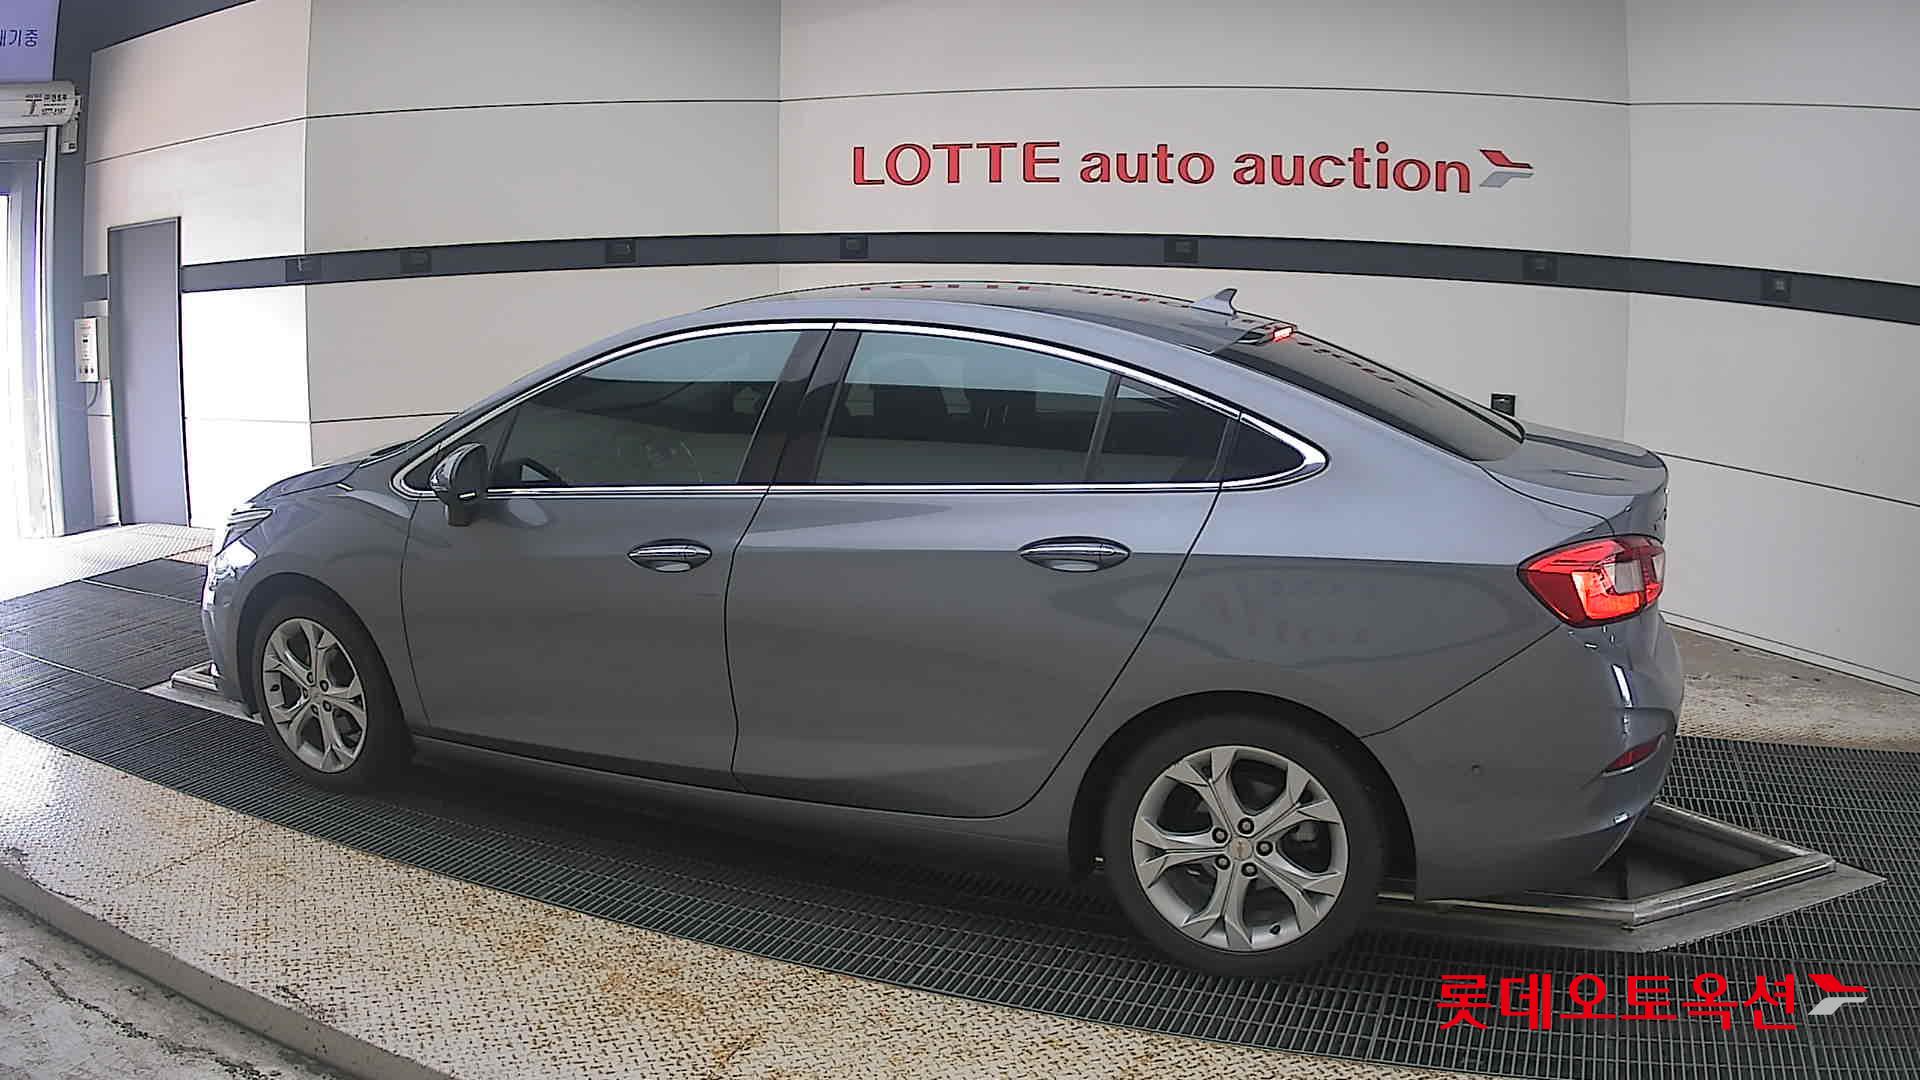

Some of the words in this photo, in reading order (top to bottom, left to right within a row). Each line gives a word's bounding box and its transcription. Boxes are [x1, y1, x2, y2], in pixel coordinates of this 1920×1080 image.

[853, 142, 1060, 186] LOTTE
[1079, 143, 1216, 184] auto
[1232, 142, 1472, 193] auction
